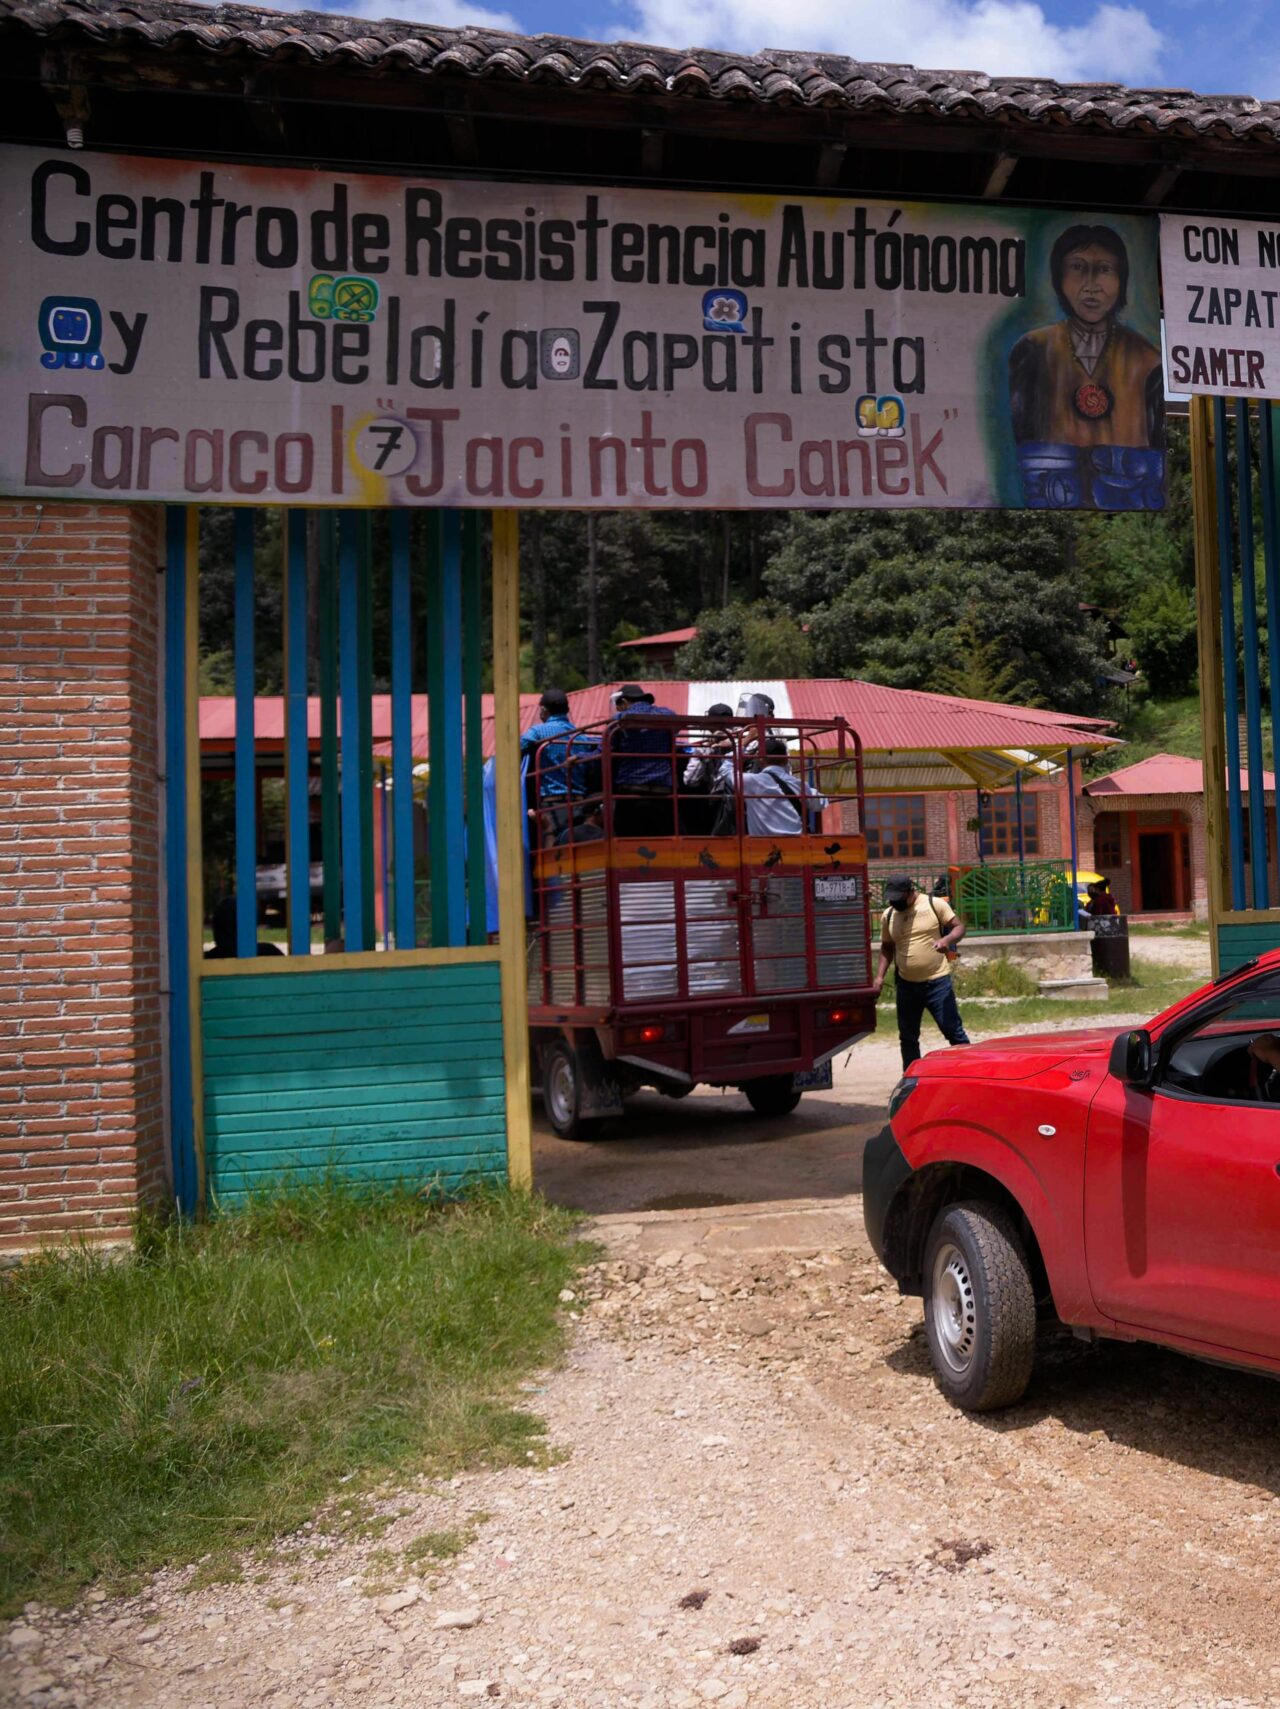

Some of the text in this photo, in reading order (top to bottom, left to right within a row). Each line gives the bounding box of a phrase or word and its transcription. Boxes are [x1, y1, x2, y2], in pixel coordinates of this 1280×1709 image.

[31, 160, 1027, 298] Centro de Resistencia Autónoma
[1184, 225, 1239, 266] CON
[108, 286, 925, 395] y Rebeldía Zapatista
[1172, 346, 1265, 390] SAMIR
[25, 393, 344, 496] Caracol
[369, 425, 404, 471] 7
